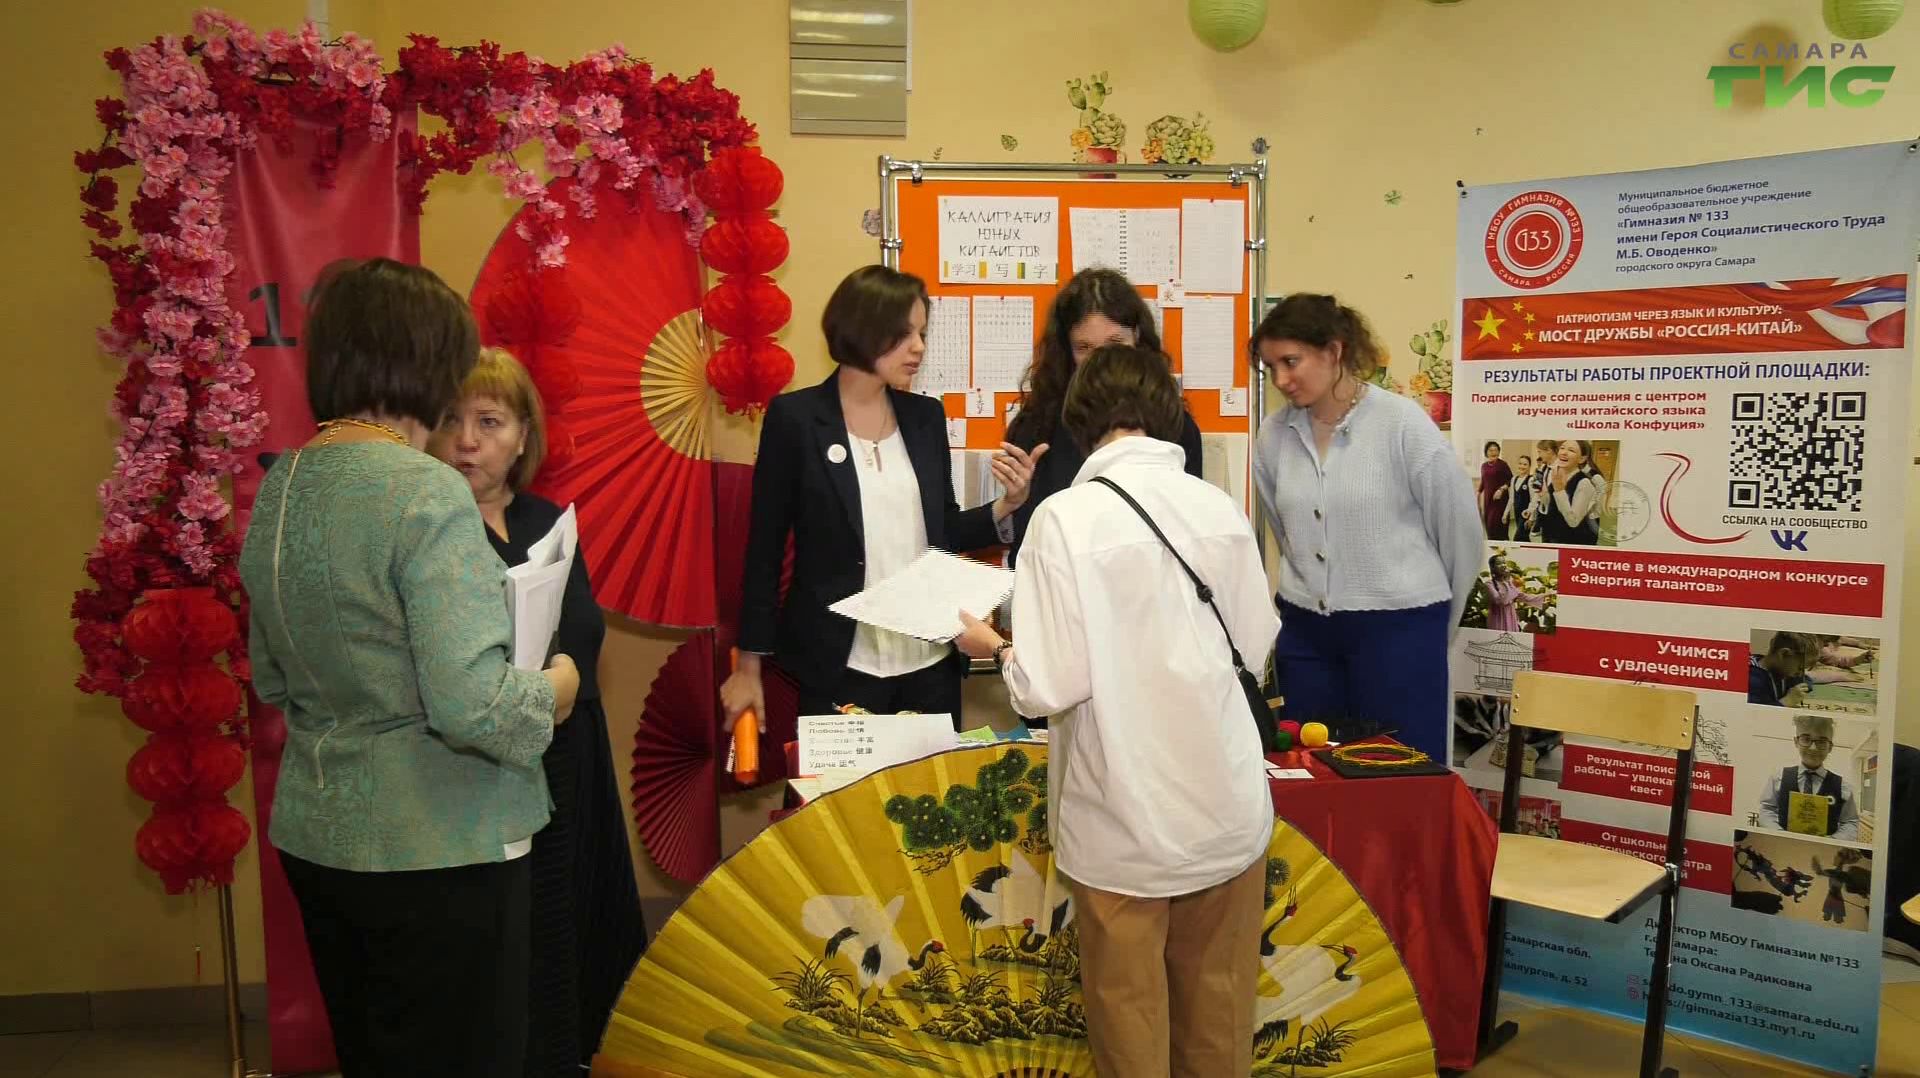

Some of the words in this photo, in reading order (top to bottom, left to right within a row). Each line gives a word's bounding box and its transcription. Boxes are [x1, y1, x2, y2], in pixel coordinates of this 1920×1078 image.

[1618, 186, 1704, 202] Муниципальное
[1706, 180, 1769, 194] бюджетное
[1618, 195, 1739, 214] общеобразовательное
[1741, 188, 1812, 206] учреждение
[948, 211, 1051, 223] КАЛЛИГРАФИЯ
[1488, 211, 1505, 240] МБОУ
[1507, 194, 1563, 211] ГИМНАЗИЯ
[1617, 215, 1685, 229] «Гимназия
[1688, 212, 1703, 224] №
[1706, 210, 1729, 222] 133
[978, 228, 1021, 240] ЮНЫХ
[1616, 234, 1658, 245] имени
[1660, 229, 1698, 244] Героя
[1701, 219, 1839, 240] Социалистического
[1842, 213, 1886, 229] Труда
[959, 245, 1040, 257] КИТАИСТОВ
[1616, 248, 1643, 260] М.Б.
[1646, 243, 1718, 259] Оводенко»
[1616, 260, 1674, 274] городского
[1676, 258, 1712, 272] округа
[1714, 255, 1756, 268] Самара
[1556, 311, 1632, 324] ПАТРИОТИЗМ
[1634, 310, 1669, 322] ЧЕРЕЗ
[1670, 308, 1704, 320] ЯЗЫК
[1706, 307, 1715, 318] И
[1717, 305, 1782, 318] КУЛЬТУРУ:
[1538, 328, 1583, 343] МОСТ
[1584, 326, 1653, 343] ДРУЖБЫ
[1657, 320, 1803, 340] «РОССИЯ-КИТАЙ»
[1484, 368, 1578, 384] РЕЗУЛЬТАТЫ
[1582, 367, 1647, 382] РАБОТЫ
[1650, 361, 1751, 381] ПРОЕКТНОЙ
[1756, 361, 1871, 381] ПЛОЩАДКИ:
[1472, 393, 1547, 404] Подписание
[1550, 392, 1631, 403] соглашения
[1634, 393, 1642, 401] с
[1646, 392, 1707, 403] центром
[1517, 406, 1578, 418] изучения
[1580, 404, 1658, 416] китайского
[1662, 406, 1706, 416] языка
[1566, 420, 1620, 430] «Школа
[1624, 419, 1705, 432] Конфуция»
[1722, 514, 1768, 526] ССЫЛКА
[1770, 516, 1786, 526] НА
[1788, 517, 1868, 530] СООБЩЕСТВО
[1571, 557, 1631, 573] Участие
[1634, 563, 1644, 572] в
[1647, 564, 1781, 583] международном
[1786, 572, 1869, 588] конкурсе
[1570, 572, 1641, 590] «Энергия
[1644, 578, 1725, 593] талантов»
[1656, 640, 1729, 661] Учимся
[1599, 658, 1609, 669] с
[1614, 658, 1728, 681] увлечением
[1586, 754, 1643, 770] Результат
[1574, 765, 1616, 778] работы
[1630, 784, 1664, 796] квест
[1601, 832, 1617, 842] От
[1566, 946, 1592, 959] обл.
[1669, 938, 1718, 956] амара:
[1709, 930, 1748, 946] МБОУ
[1750, 938, 1817, 962] Гимназии
[1819, 952, 1860, 970] №133
[1574, 976, 1588, 987] 52
[1690, 954, 1737, 976] Оксана
[1739, 966, 1812, 992] Радиковна
